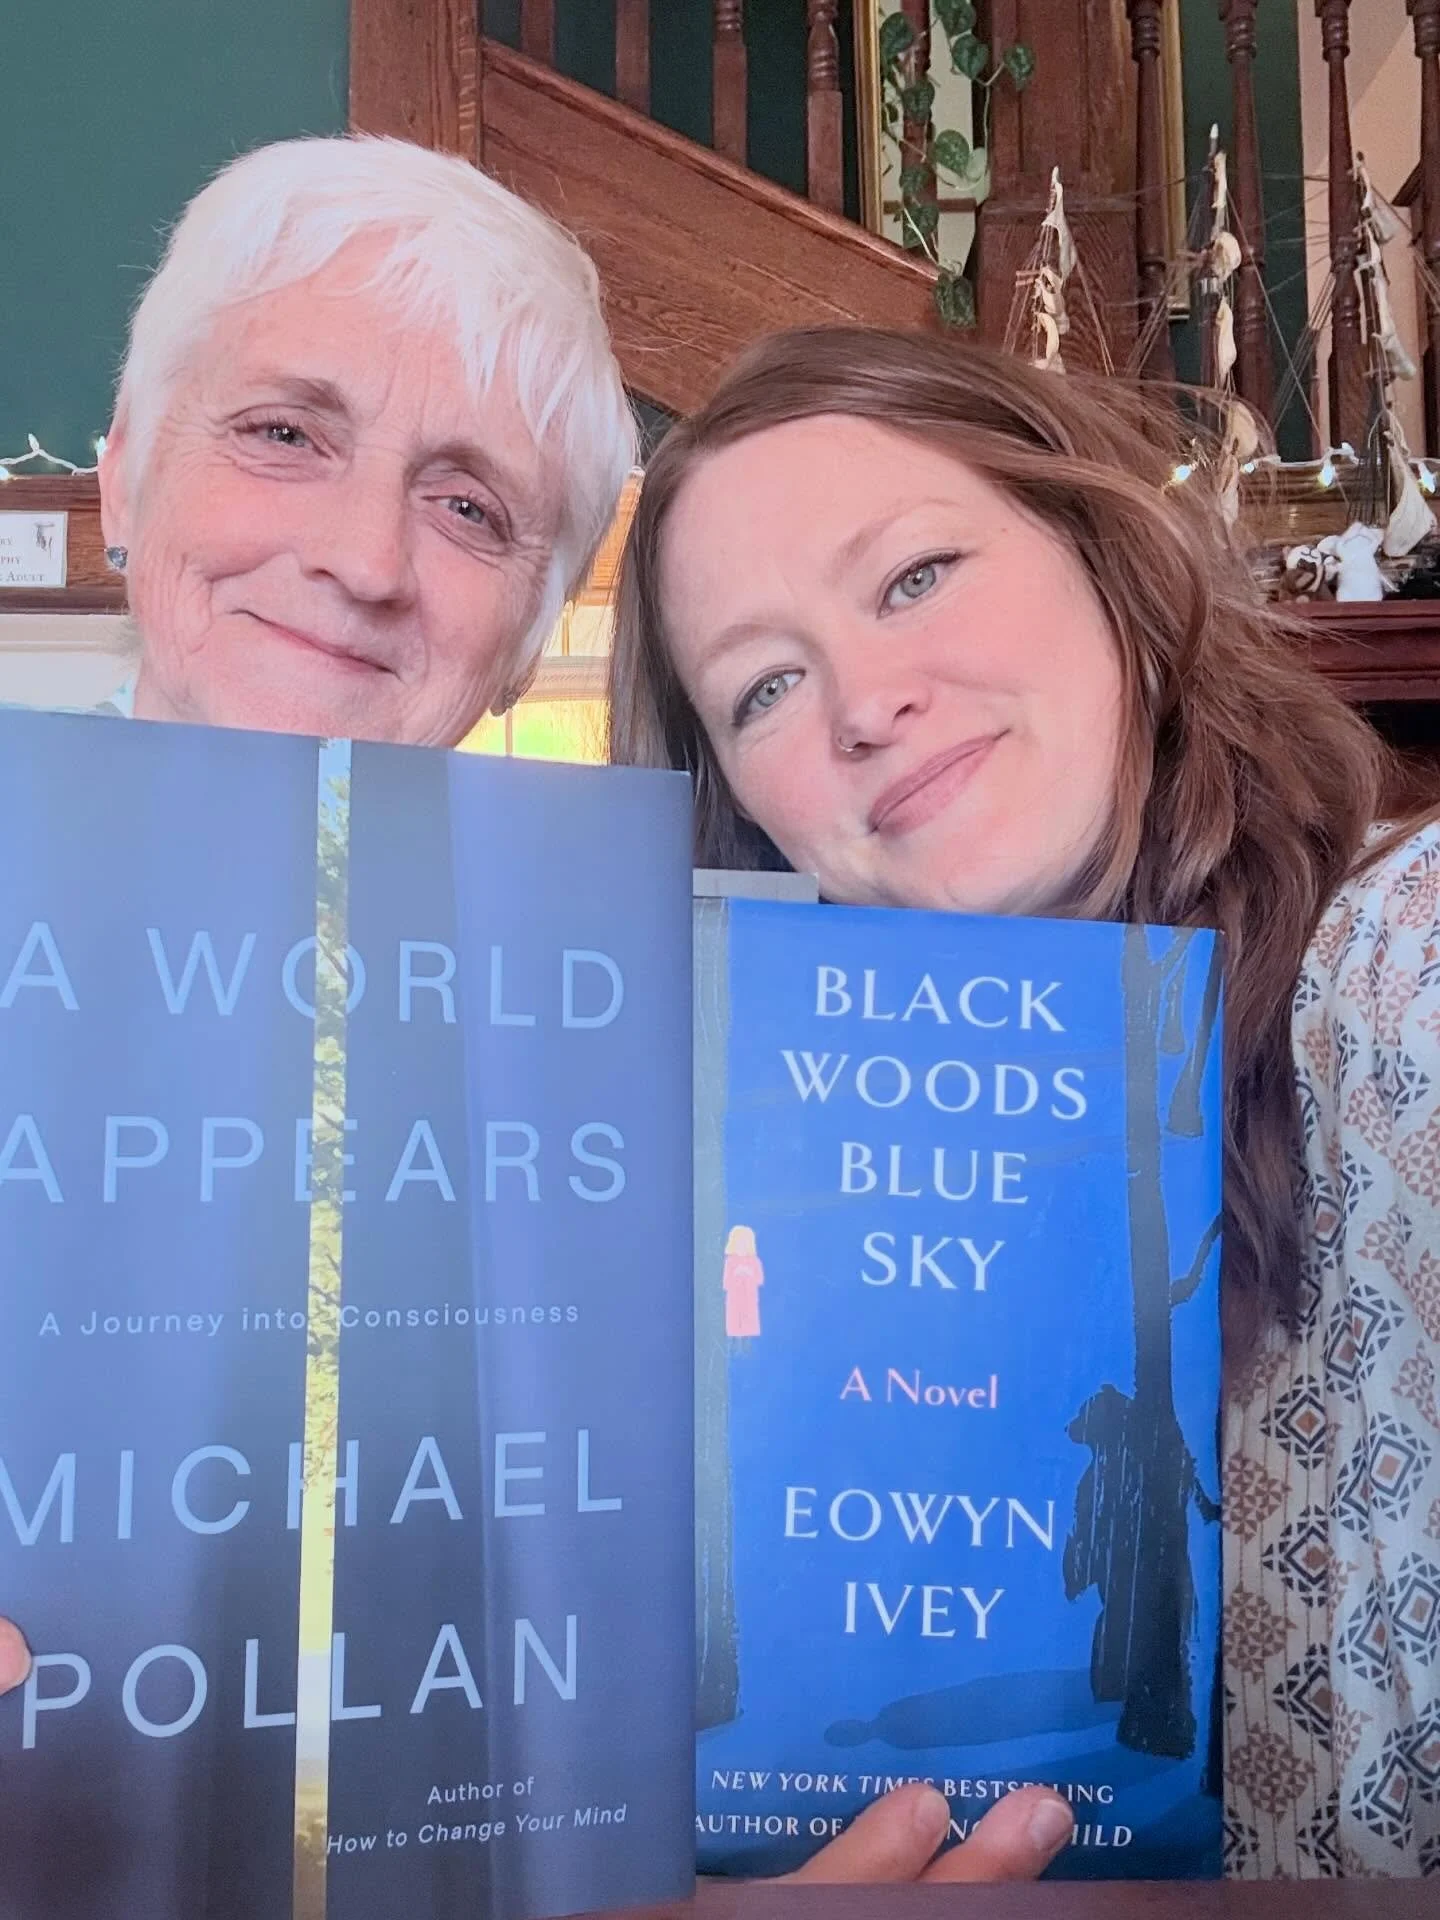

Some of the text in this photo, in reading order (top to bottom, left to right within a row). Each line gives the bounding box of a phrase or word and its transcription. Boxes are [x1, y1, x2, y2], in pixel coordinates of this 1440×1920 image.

[0, 921, 625, 1029] A WORLD
[814, 965, 1067, 1033] BLACK
[780, 1049, 1088, 1121] WOODS
[0, 1114, 626, 1203] APPEARS
[839, 1141, 1030, 1205] BLUE
[861, 1231, 1006, 1292] SKY
[39, 1303, 580, 1337] A Journey into Consciousness
[840, 1366, 999, 1410] A Novel
[0, 1429, 623, 1546] MICHAEL
[783, 1485, 1056, 1552] EOWYN
[844, 1582, 1006, 1640] IVEY
[21, 1614, 578, 1750] POLLAN
[427, 1776, 535, 1805] Author of
[711, 1770, 772, 1791] NEW
[778, 1772, 848, 1793] YORK
[944, 1778, 1114, 1804] BESTSING
[327, 1803, 628, 1855] How to Change Your Mind
[695, 1813, 843, 1837] AUTHOR OF
